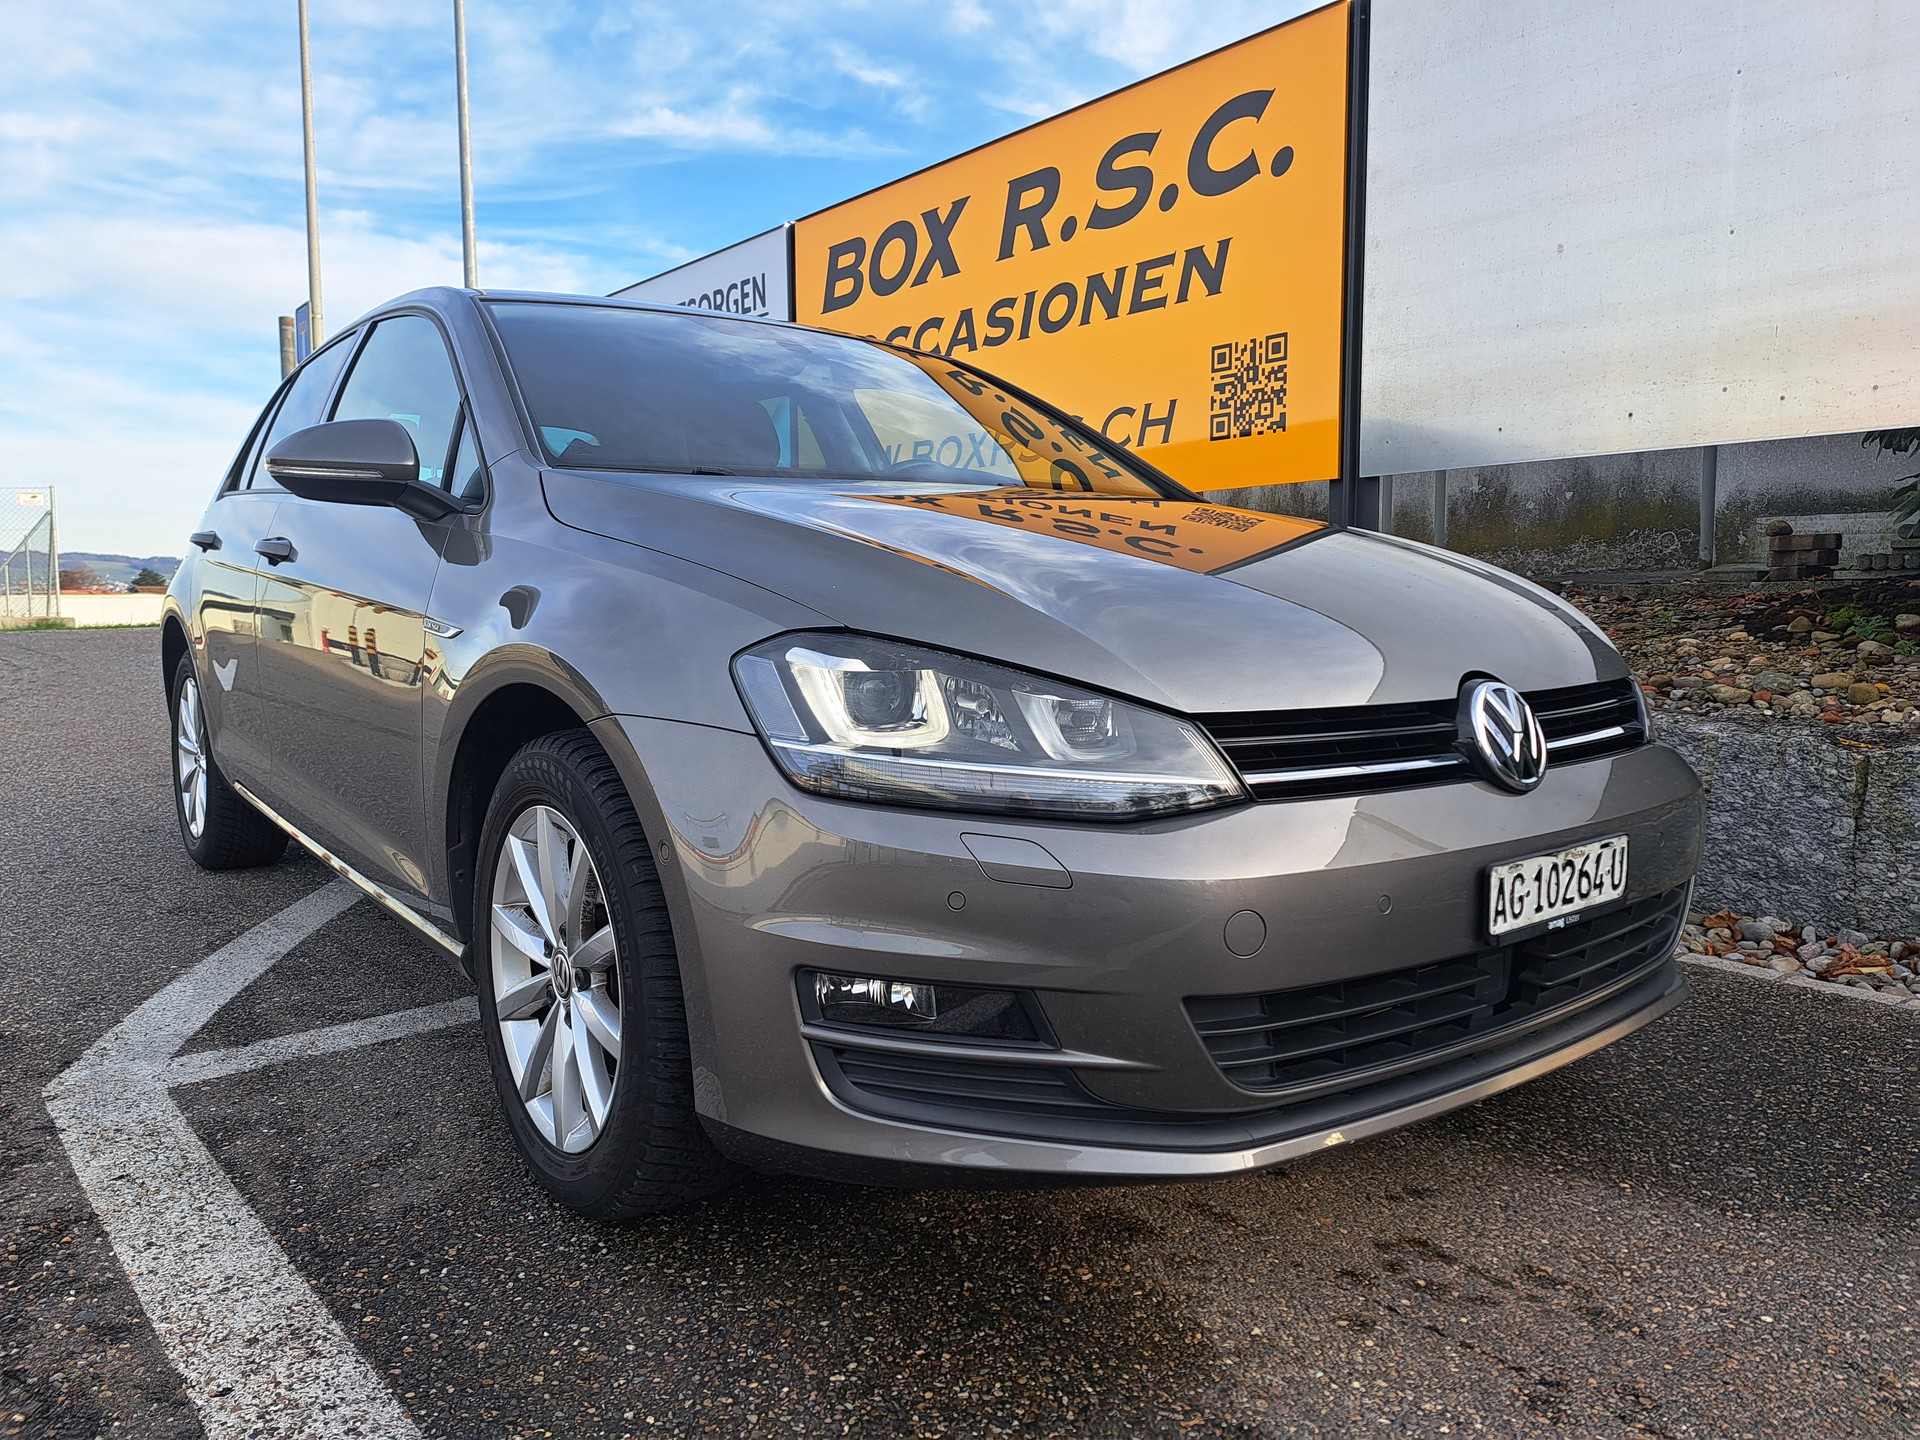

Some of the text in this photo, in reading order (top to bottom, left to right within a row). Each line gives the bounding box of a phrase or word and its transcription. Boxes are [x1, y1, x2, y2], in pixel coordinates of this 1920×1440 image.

[821, 88, 1295, 314] BOX R.S.C.
[866, 237, 1234, 356] CASIONEN
